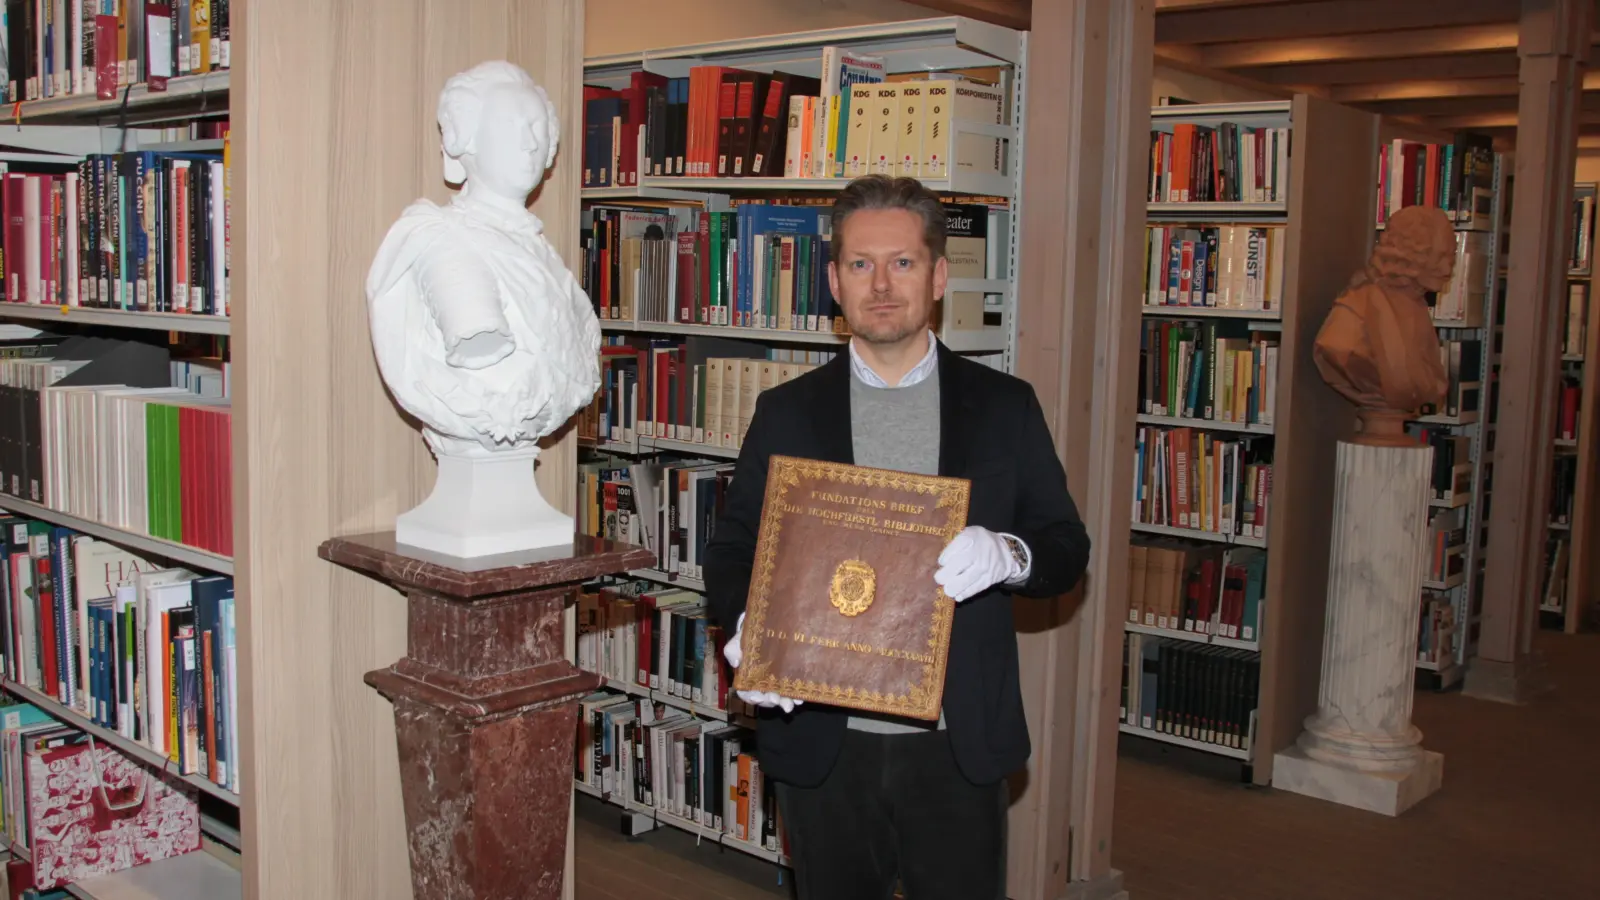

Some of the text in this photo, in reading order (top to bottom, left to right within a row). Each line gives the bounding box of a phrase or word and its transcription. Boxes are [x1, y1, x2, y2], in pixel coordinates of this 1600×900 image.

[853, 89, 871, 98] KDG
[878, 89, 896, 98] KDG
[903, 88, 921, 98] KDG
[929, 87, 947, 97] KDG
[956, 87, 998, 101] KOMPONISTEN
[79, 163, 87, 221] WAGNER
[135, 157, 144, 215] PUCCINI
[111, 160, 119, 238] MENDELSSOHN
[946, 216, 973, 230] eater
[1246, 229, 1259, 279] KUNST
[1192, 259, 1205, 291] Design
[811, 491, 925, 515] FUNDATIONS BRIEF
[783, 504, 803, 514] DIE
[883, 519, 947, 537] BIBLIOTHEC
[793, 632, 805, 643] VI
[844, 643, 873, 653] ANNO
